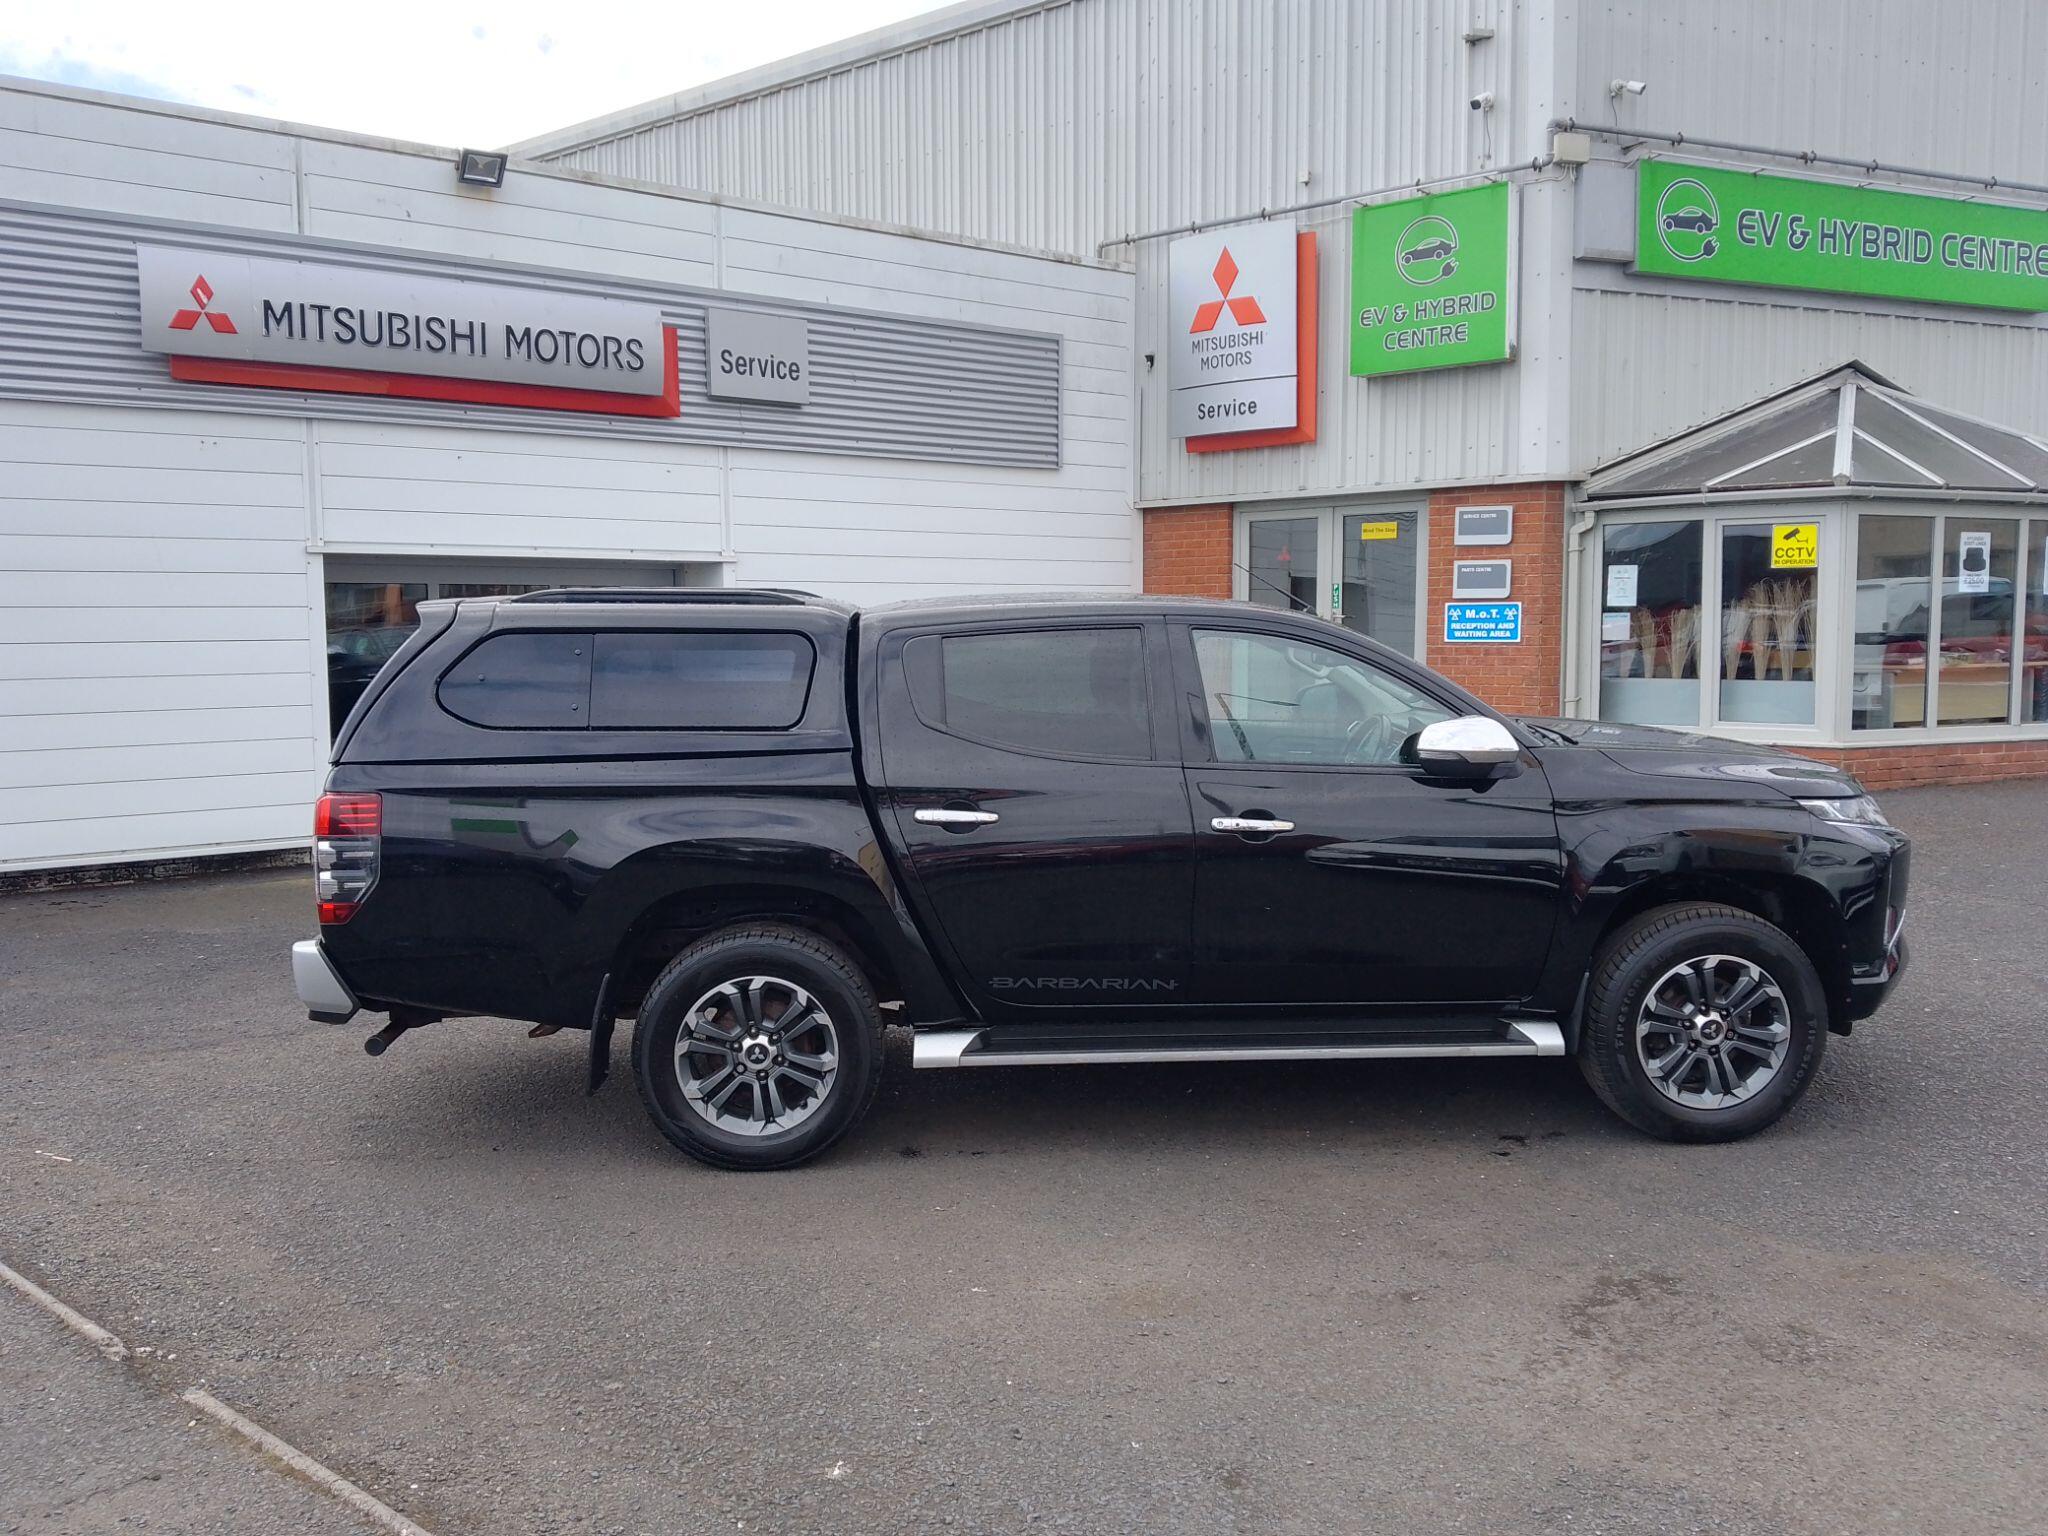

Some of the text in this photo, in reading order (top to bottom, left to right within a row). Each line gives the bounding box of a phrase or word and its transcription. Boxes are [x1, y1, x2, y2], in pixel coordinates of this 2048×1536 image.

[1737, 208, 2048, 277] EV & HYBRID CENTRE
[1360, 292, 1496, 327] EV & HYBRID
[261, 299, 646, 372] MITSUBISHI MOTORS
[1191, 330, 1263, 354] MITSUBISHI
[1384, 323, 1468, 351] CENTRE
[719, 349, 802, 382] Service
[1200, 350, 1252, 371] MOTORS
[1197, 399, 1258, 420] Service
[1775, 547, 1815, 559] CCTV
[1453, 630, 1512, 638] WAITING AREA
[990, 976, 1177, 991] BARBARIAN
